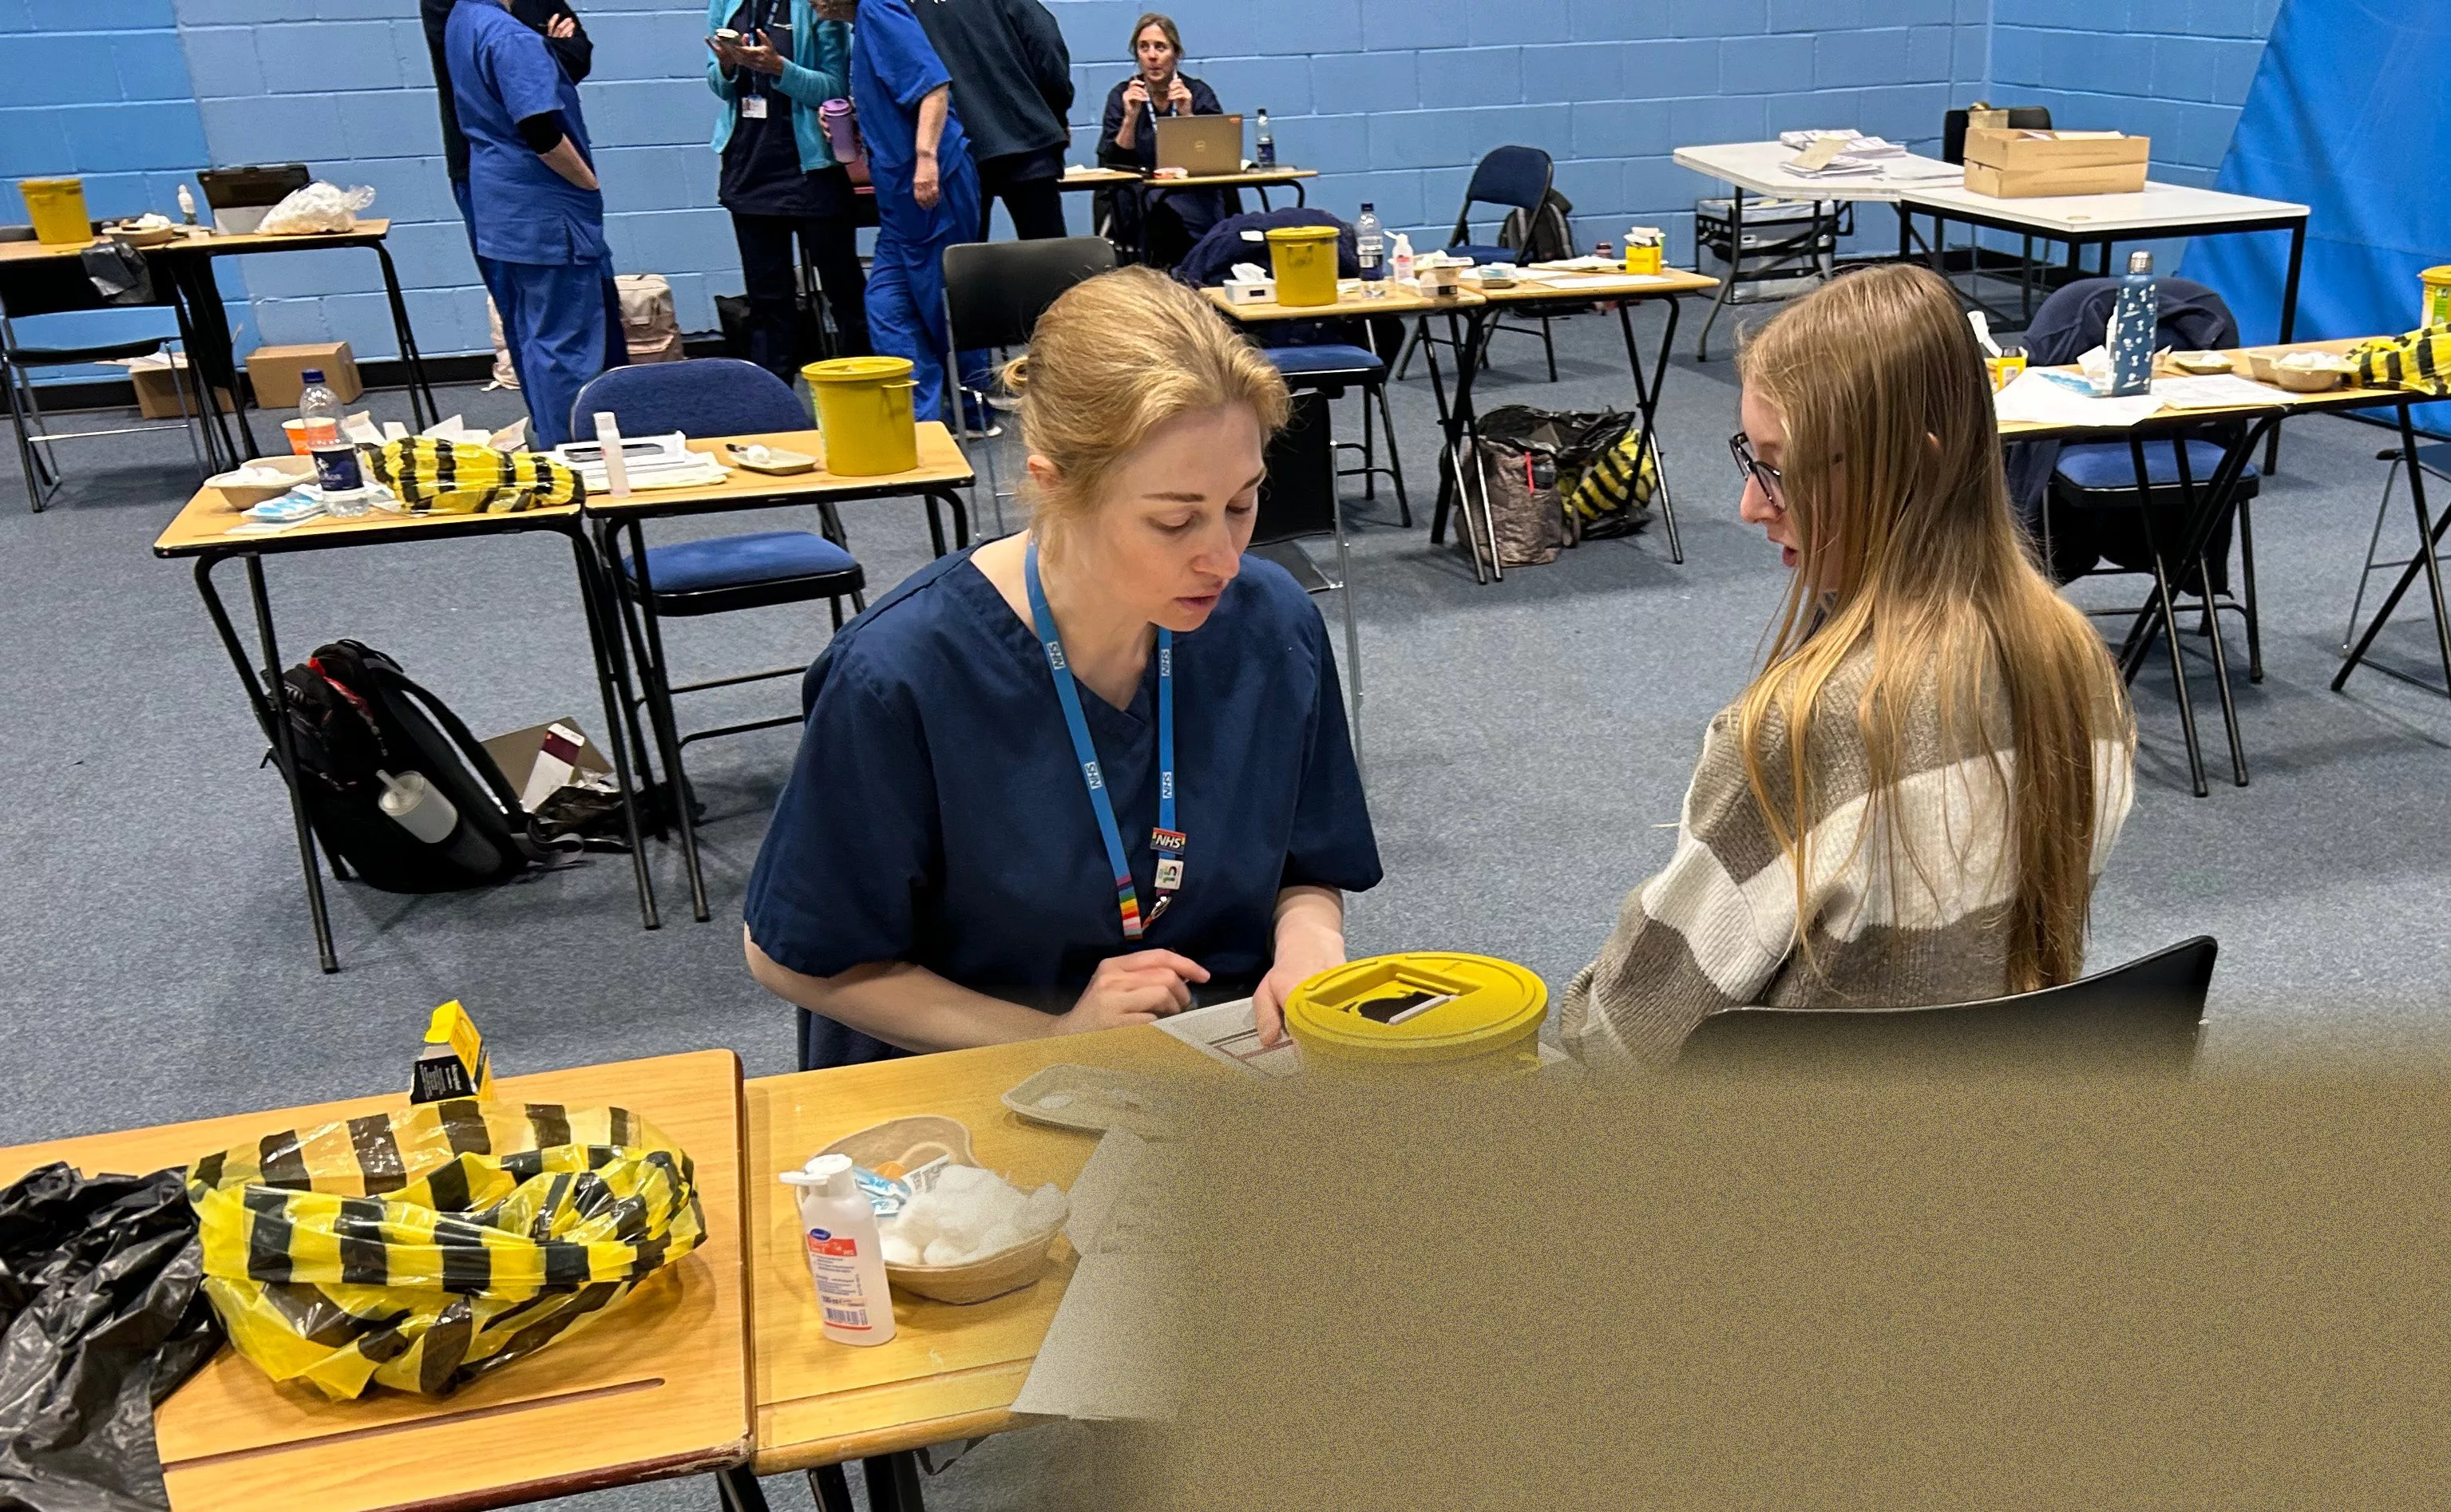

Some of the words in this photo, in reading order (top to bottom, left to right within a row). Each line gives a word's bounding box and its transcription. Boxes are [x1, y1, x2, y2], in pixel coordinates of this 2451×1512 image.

[1050, 643, 1064, 667] NHS
[1087, 763, 1101, 787] NHS
[1155, 834, 1182, 849] NHS
